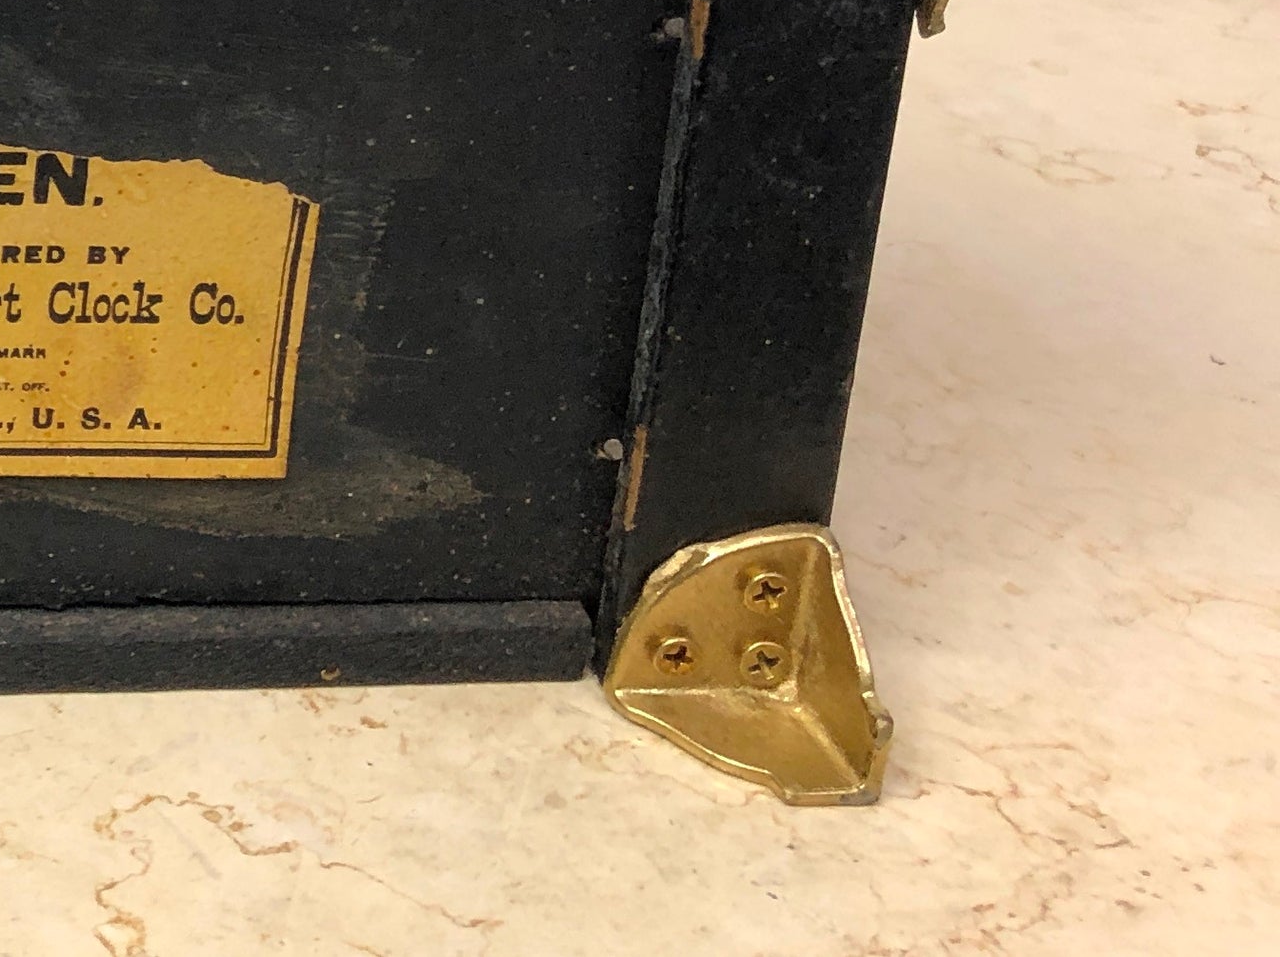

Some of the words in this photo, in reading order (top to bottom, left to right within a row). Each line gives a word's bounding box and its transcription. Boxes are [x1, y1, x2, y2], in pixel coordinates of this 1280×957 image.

[87, 245, 131, 265] BY
[48, 280, 164, 325] Clock
[189, 282, 245, 325] Co.
[21, 382, 50, 392] OFF.
[31, 406, 65, 430] U.
[80, 406, 112, 431] S.
[127, 407, 162, 431] A.
